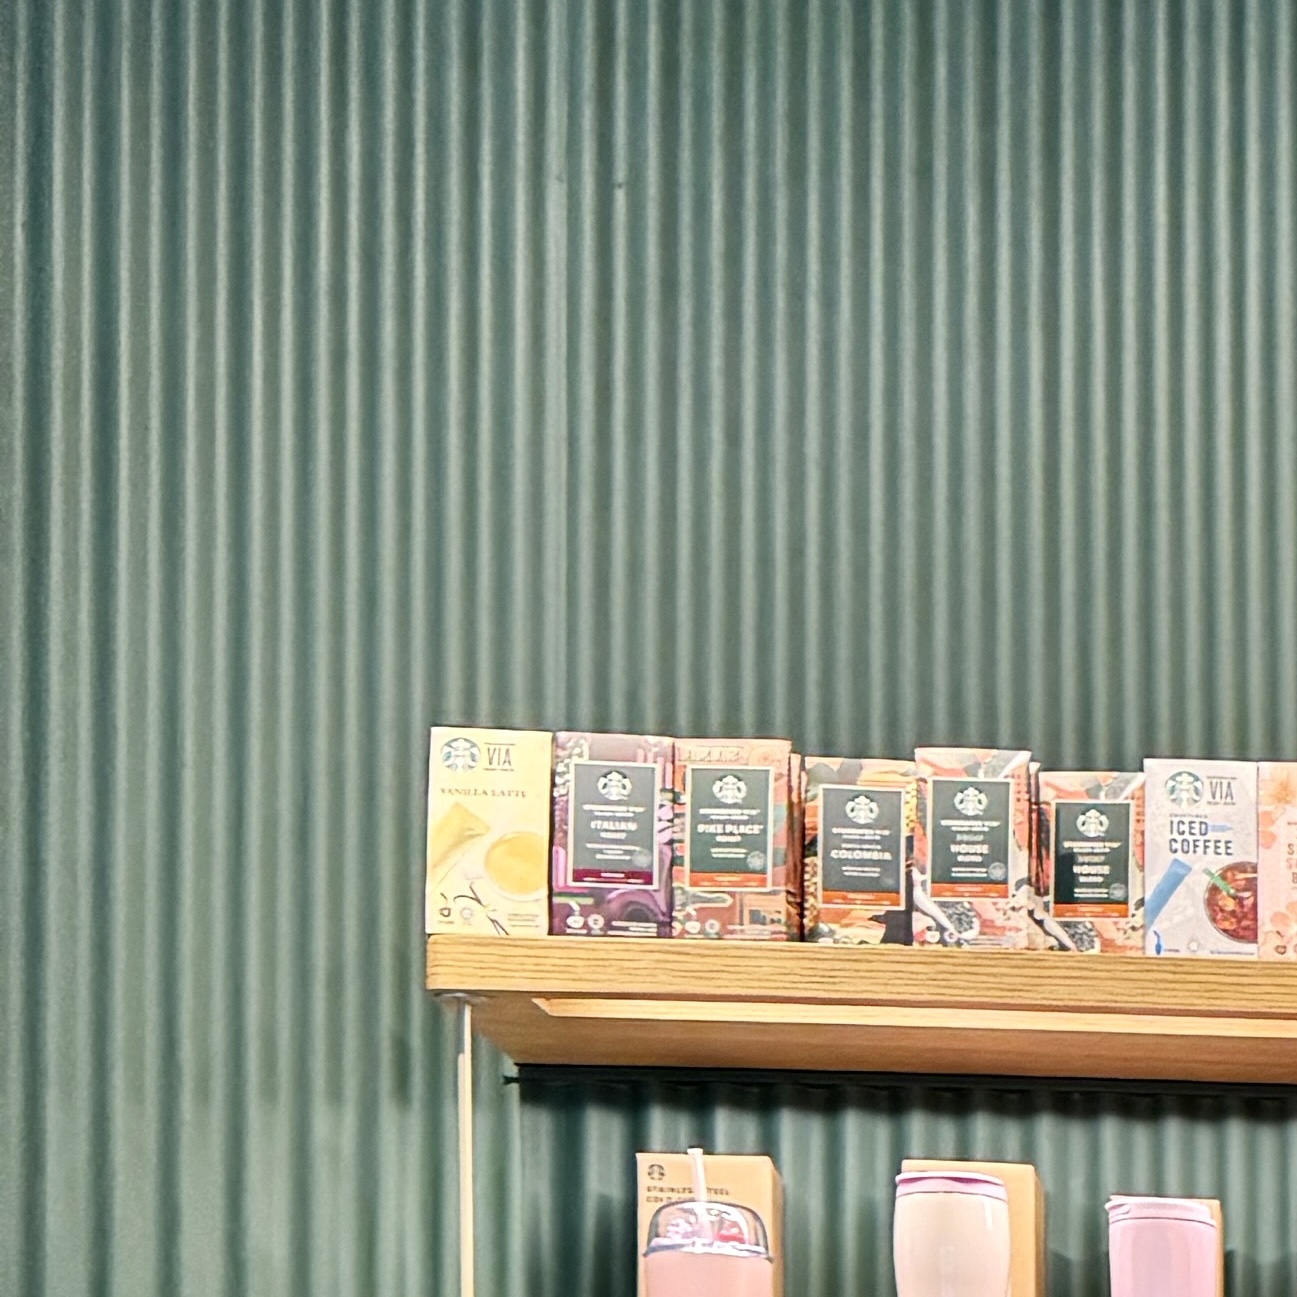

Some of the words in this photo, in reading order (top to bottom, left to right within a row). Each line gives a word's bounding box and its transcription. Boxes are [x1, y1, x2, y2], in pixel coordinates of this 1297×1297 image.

[487, 747, 512, 766] VIA
[440, 788, 488, 797] VANILLA
[491, 789, 526, 799] LATTE
[1210, 781, 1234, 801] VIA
[590, 820, 638, 831] ITALIAN
[1170, 820, 1208, 836] ICED
[950, 844, 989, 854] HOUSE
[1169, 838, 1234, 856] COFFEE
[830, 849, 892, 861] COLOMBIA
[1073, 865, 1110, 875] HOUSE
